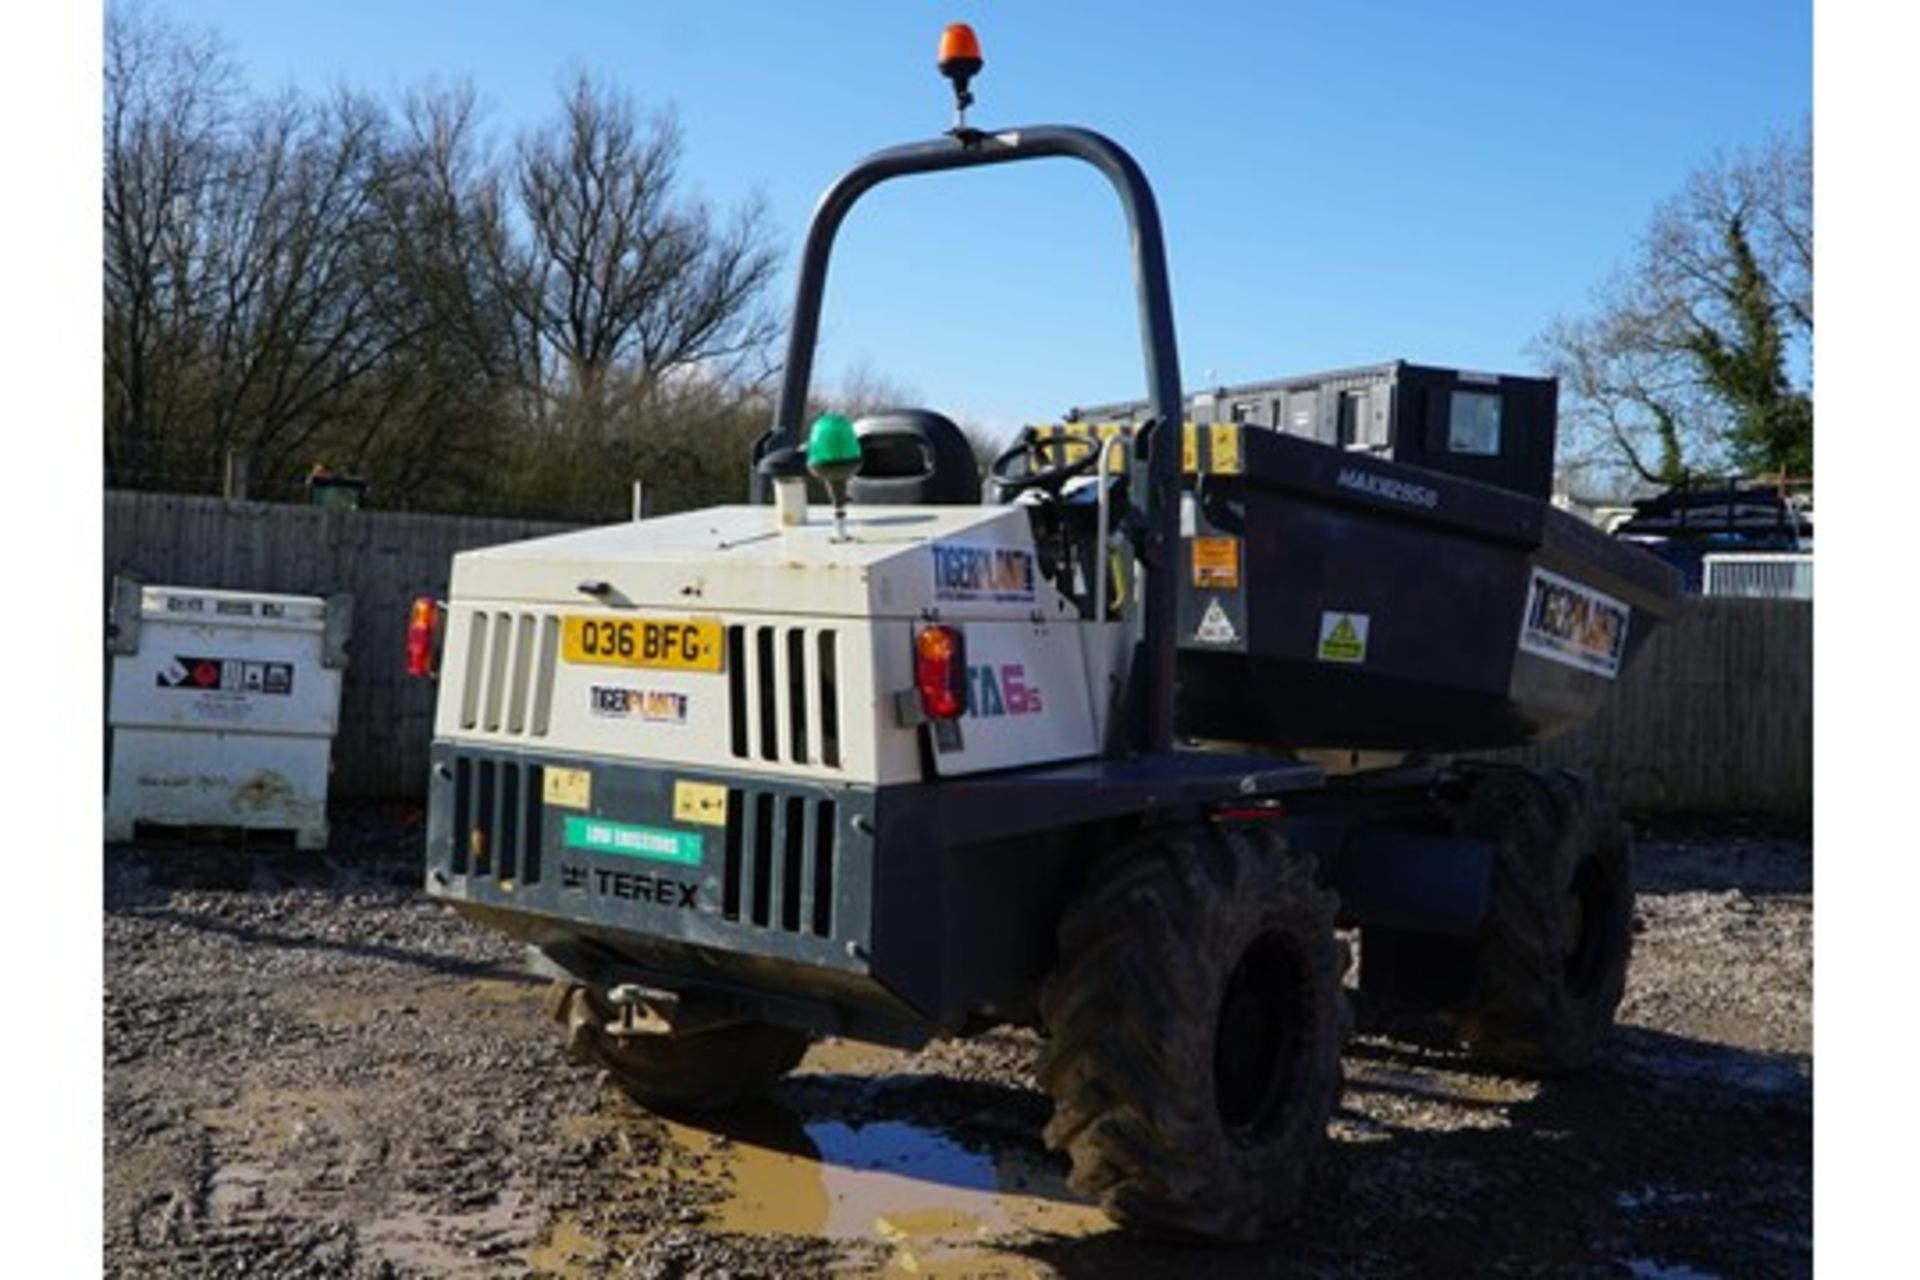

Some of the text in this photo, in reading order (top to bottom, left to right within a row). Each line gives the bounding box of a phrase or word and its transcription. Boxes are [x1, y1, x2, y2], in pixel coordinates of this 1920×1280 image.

[582, 621, 699, 662] Q36 BFG
[594, 867, 698, 910] TEREX
